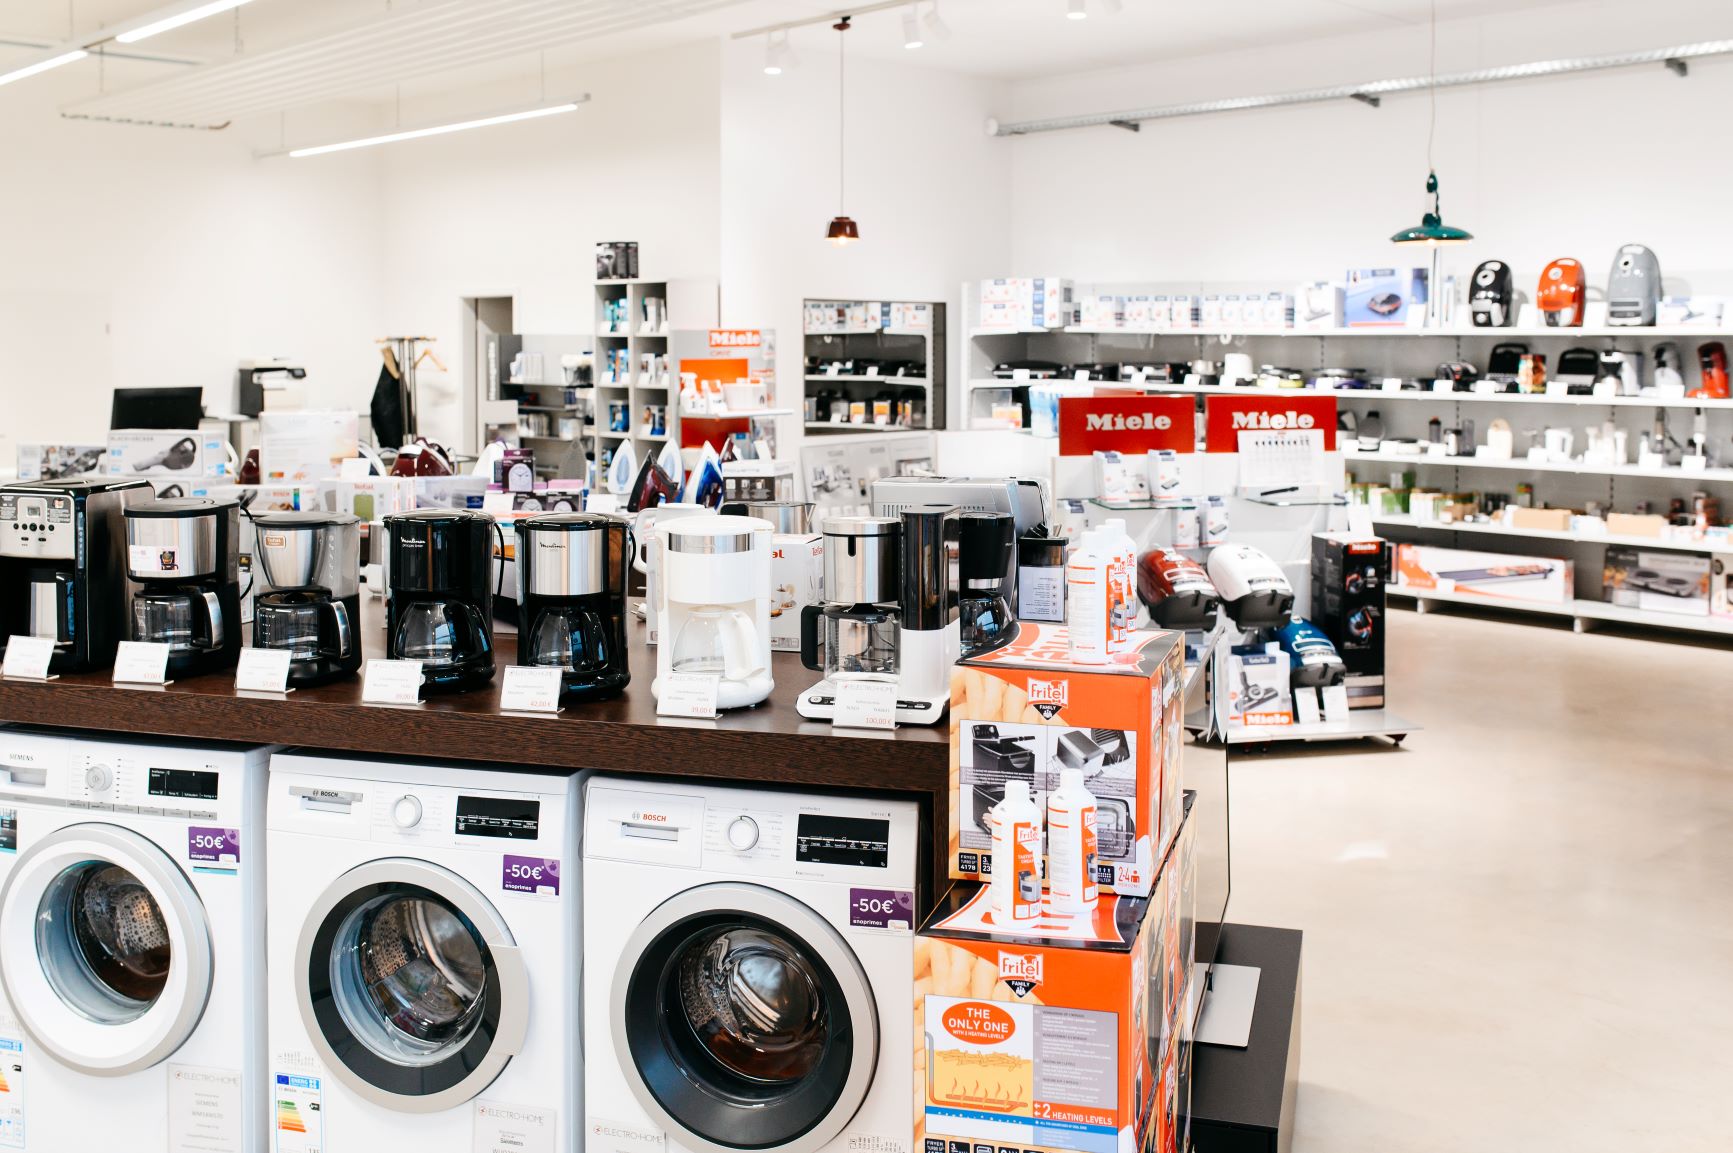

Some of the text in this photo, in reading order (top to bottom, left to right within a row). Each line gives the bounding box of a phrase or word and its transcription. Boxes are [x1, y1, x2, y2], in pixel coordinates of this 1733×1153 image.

[711, 332, 760, 345] Miele
[1086, 413, 1172, 431] Miele
[1232, 411, 1315, 430] Miele
[9, 753, 34, 761] SIEMENS
[642, 813, 667, 822] BOSCH
[1011, 980, 1031, 988] FAMILY
[966, 1007, 991, 1020] THE
[948, 1018, 1009, 1034] ONLY ONE
[487, 1108, 545, 1124] ELECTRO-HOME
[1042, 1103, 1113, 1126] 2 HEATING LEVELS
[603, 1127, 663, 1144] ELECTRO-HOME
